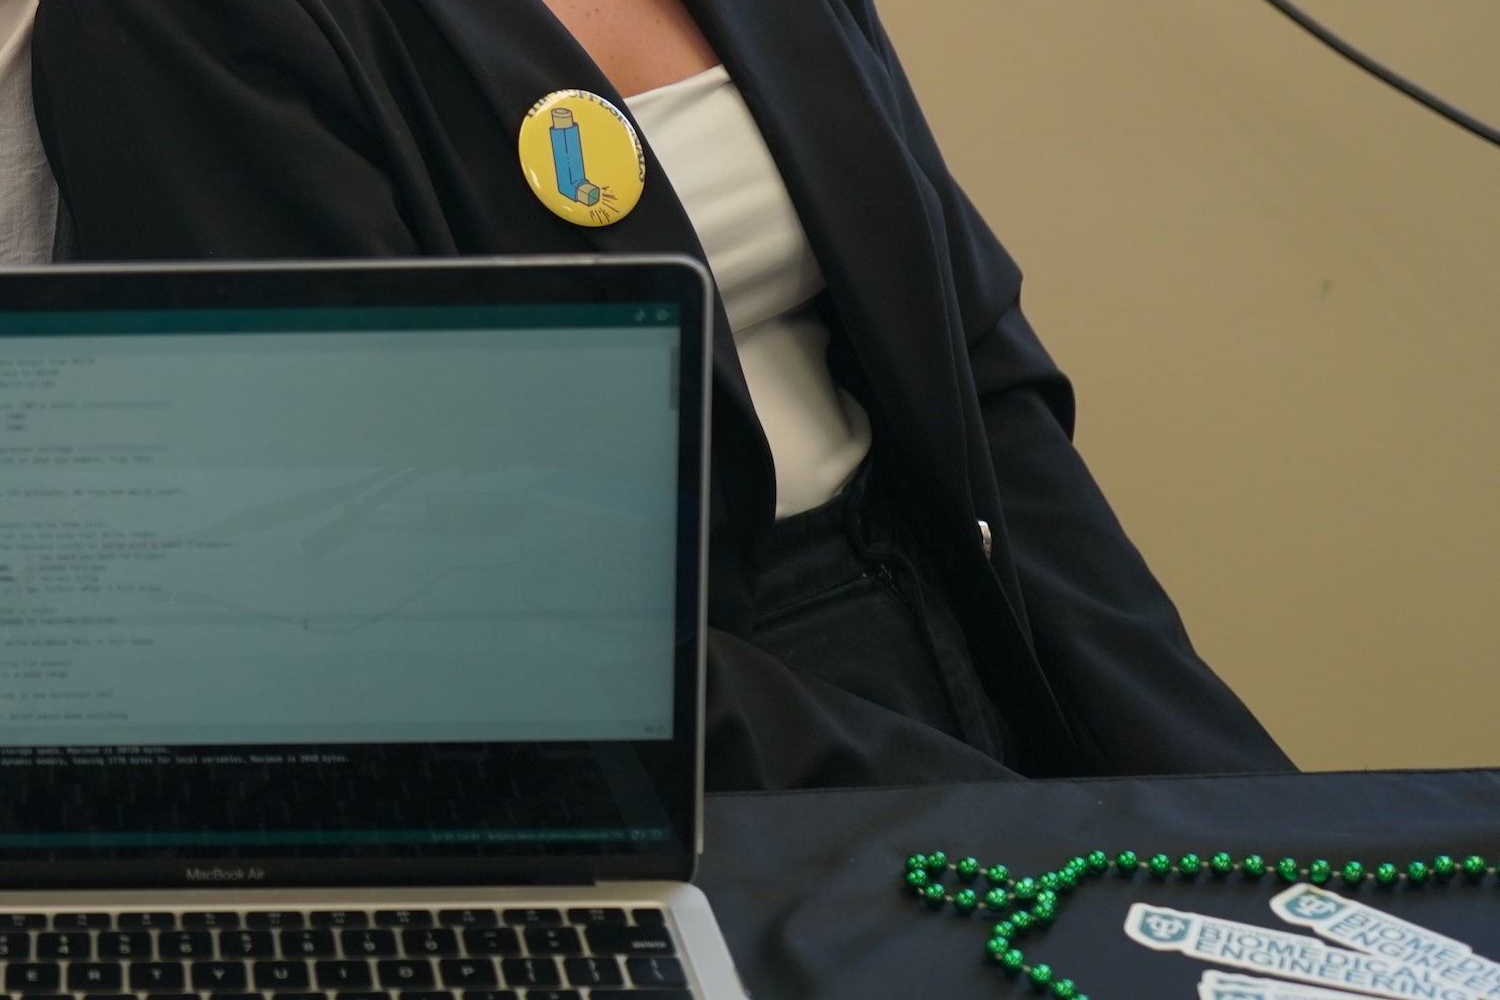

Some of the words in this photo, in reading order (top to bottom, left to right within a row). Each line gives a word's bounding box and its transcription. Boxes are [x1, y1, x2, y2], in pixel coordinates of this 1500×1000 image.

[186, 868, 244, 880] MacBook
[248, 868, 265, 880] Air
[26, 970, 38, 982] E
[87, 969, 101, 982] R
[150, 969, 163, 981] T
[212, 968, 226, 980] Y
[274, 967, 288, 980] U
[340, 966, 347, 979] I
[398, 966, 413, 979] O
[461, 965, 475, 977] P
[1194, 938, 1468, 1000] ENGINEERING
[1198, 925, 1445, 986] BIOMEDICAL
